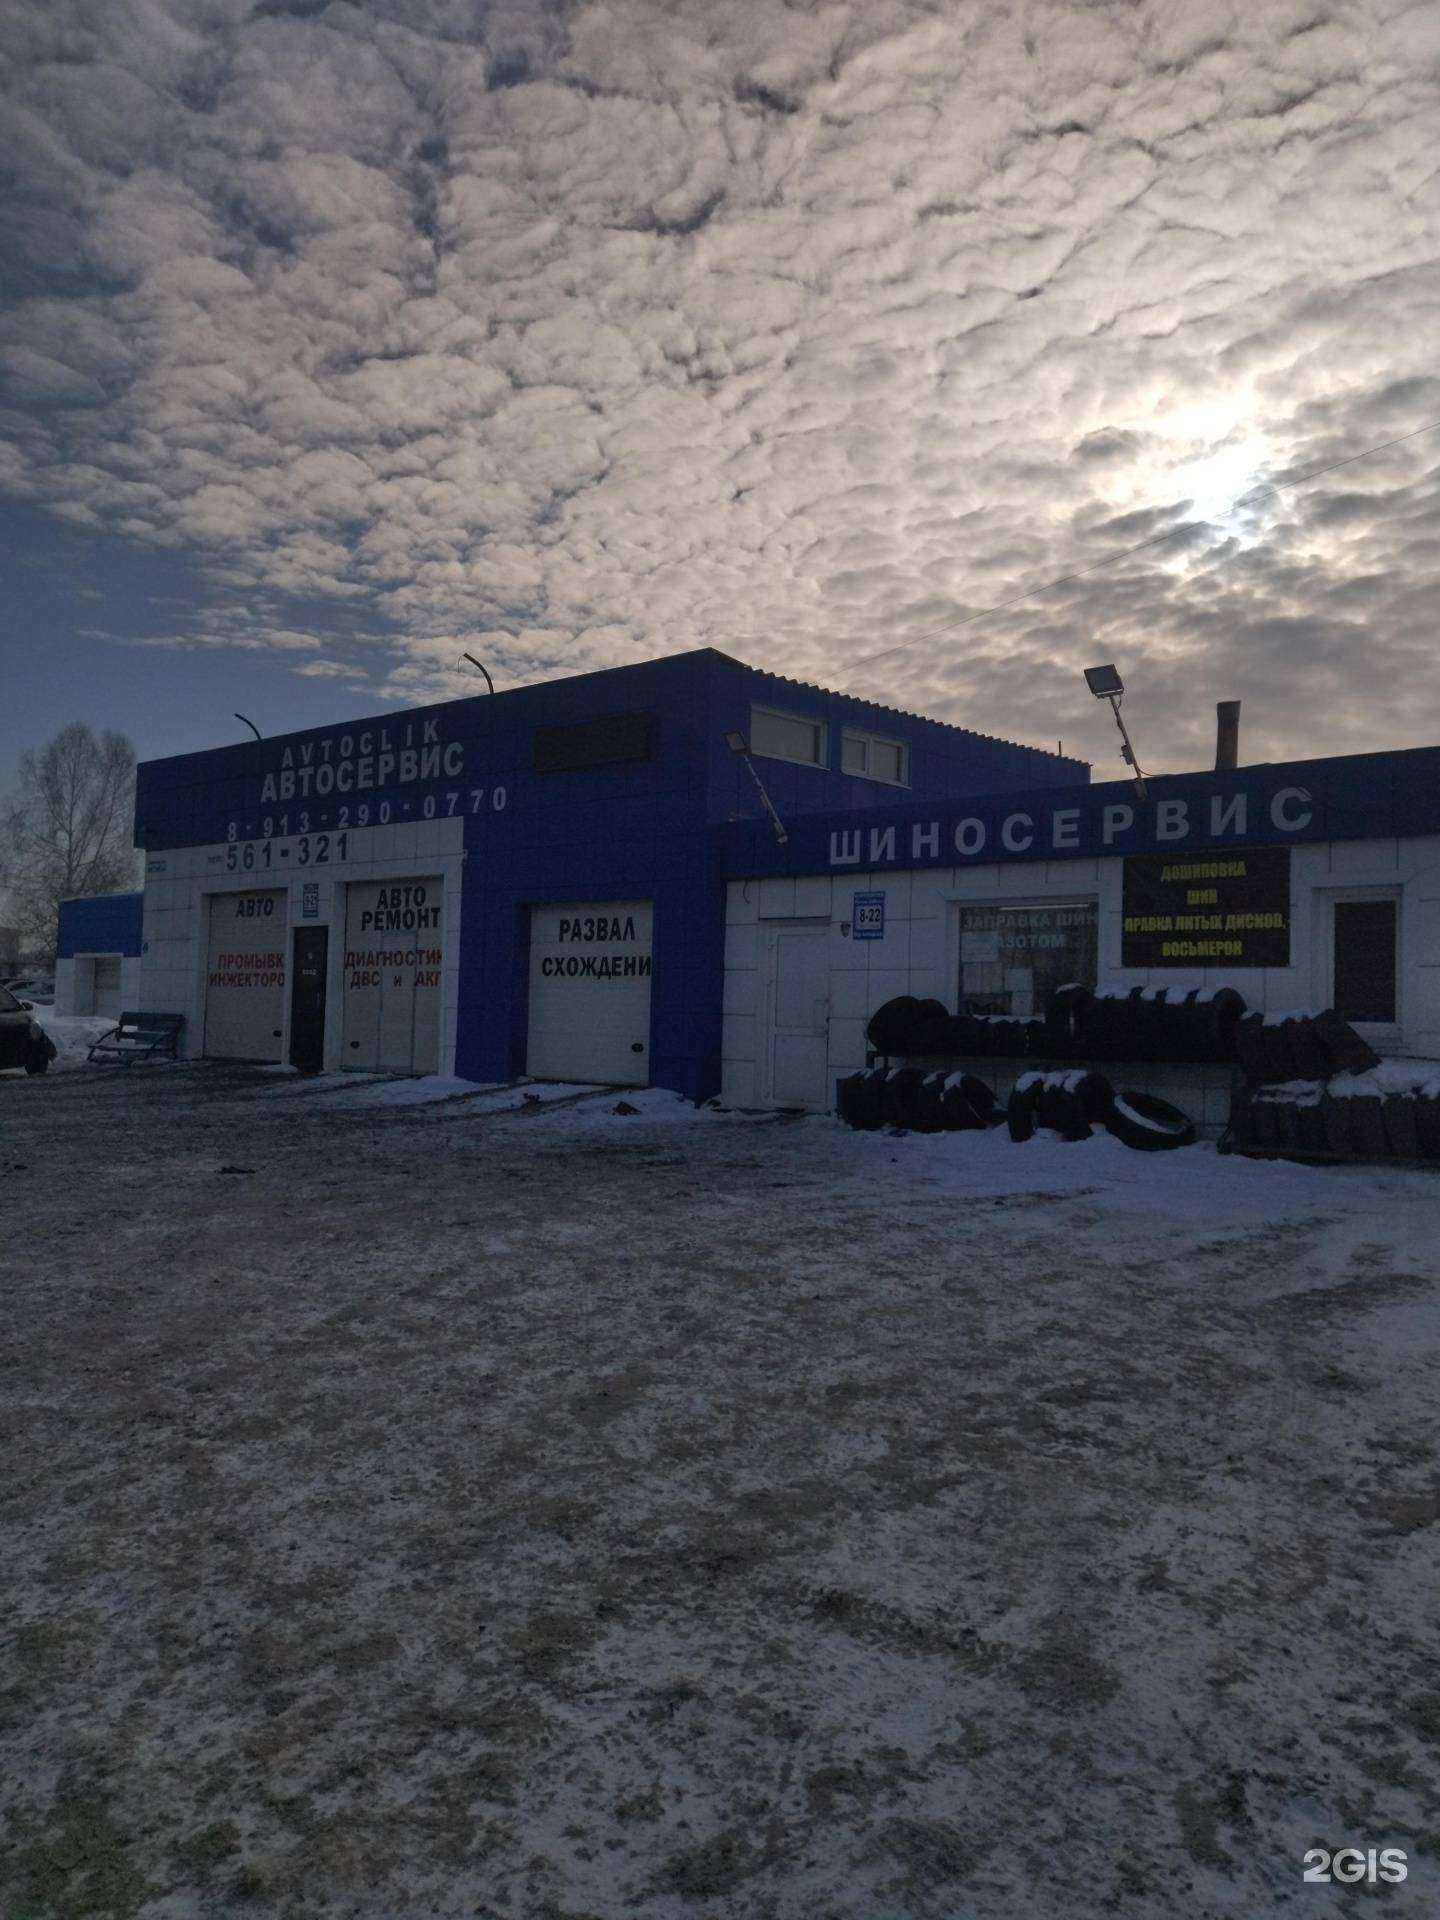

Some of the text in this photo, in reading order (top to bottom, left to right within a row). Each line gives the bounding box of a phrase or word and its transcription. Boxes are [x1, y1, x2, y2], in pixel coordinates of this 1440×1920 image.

[282, 718, 440, 768] AVTOCLIK
[260, 742, 465, 803] АВТОСЕРВИС
[829, 786, 1313, 865] ШИНОСЕРВИС
[226, 832, 348, 871] 561-321
[1161, 861, 1247, 882] ДОШИПОВКА
[235, 897, 275, 918] АВТО
[376, 886, 427, 910] АВТО
[1187, 889, 1218, 905] ШИН
[361, 907, 441, 931] РЕМОНТ
[558, 916, 636, 942] РАЗВАЛ
[1124, 915, 1173, 932] ПРАВКА
[541, 955, 652, 980] СХОЖДЕНИ
[350, 971, 382, 990] ДВС
